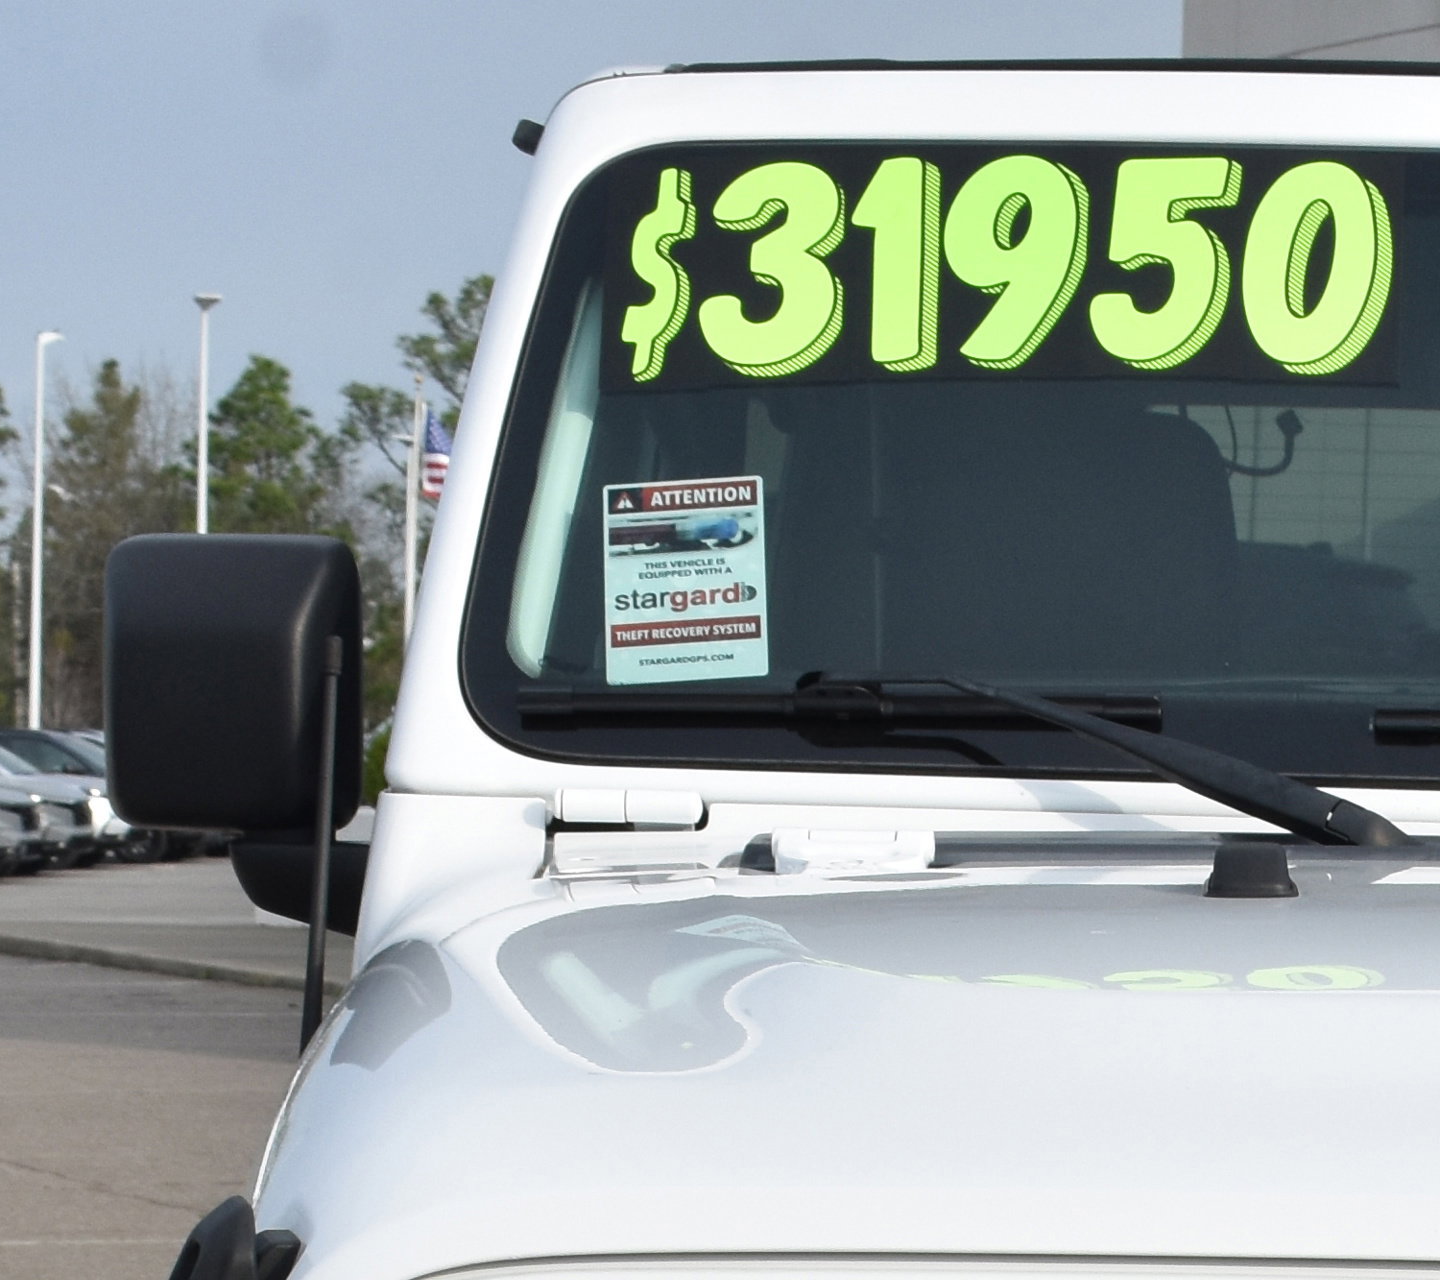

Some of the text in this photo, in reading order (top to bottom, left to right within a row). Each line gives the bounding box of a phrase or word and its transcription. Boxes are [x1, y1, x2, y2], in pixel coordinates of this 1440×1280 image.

[621, 154, 1393, 383] $31950
[650, 485, 752, 507] ATTENTION
[638, 570, 692, 579] EQUIPPED
[695, 568, 722, 576] WITH
[644, 560, 667, 570] THIS
[669, 559, 714, 568] VEHICLE
[614, 581, 741, 612] stargard
[615, 622, 757, 642] THEFT RECOVERY SYSTEM
